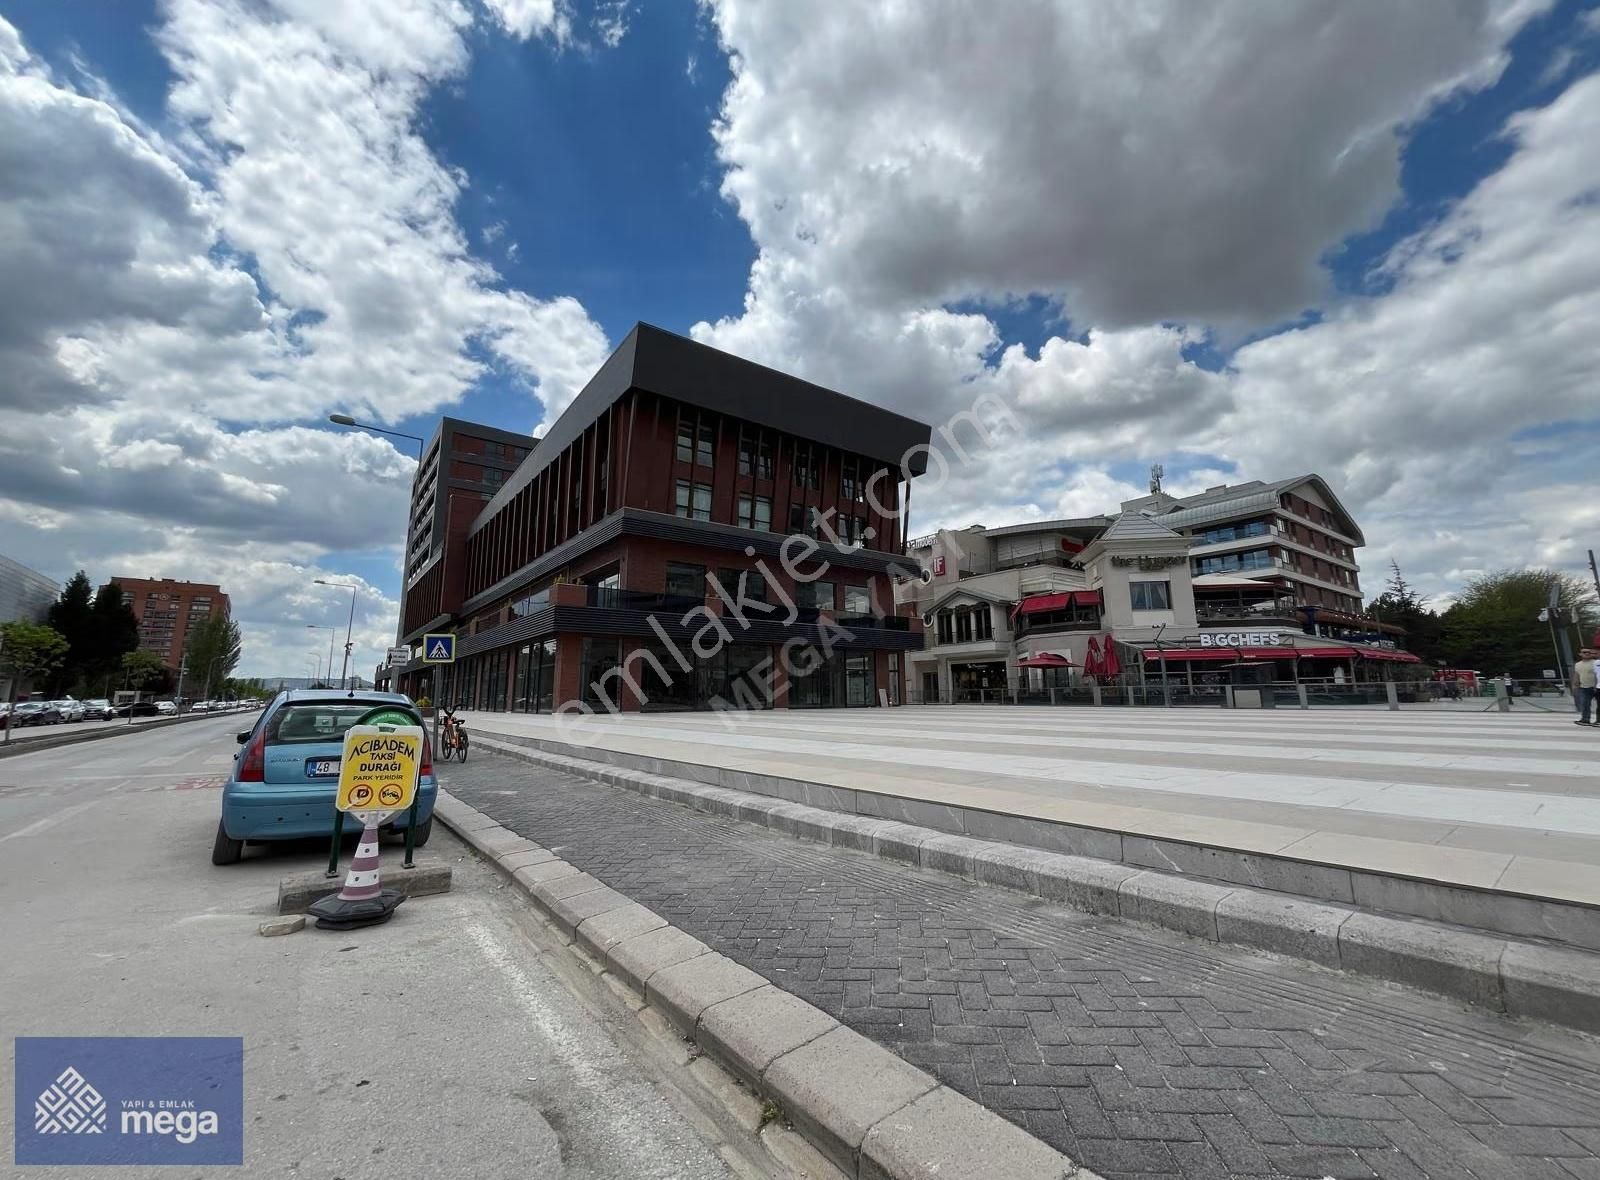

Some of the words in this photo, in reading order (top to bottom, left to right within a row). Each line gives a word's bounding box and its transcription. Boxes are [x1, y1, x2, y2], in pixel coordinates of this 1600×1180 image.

[933, 556, 944, 573] IF
[348, 739, 415, 761] ACIBADEM
[359, 762, 401, 771] DURAĞI
